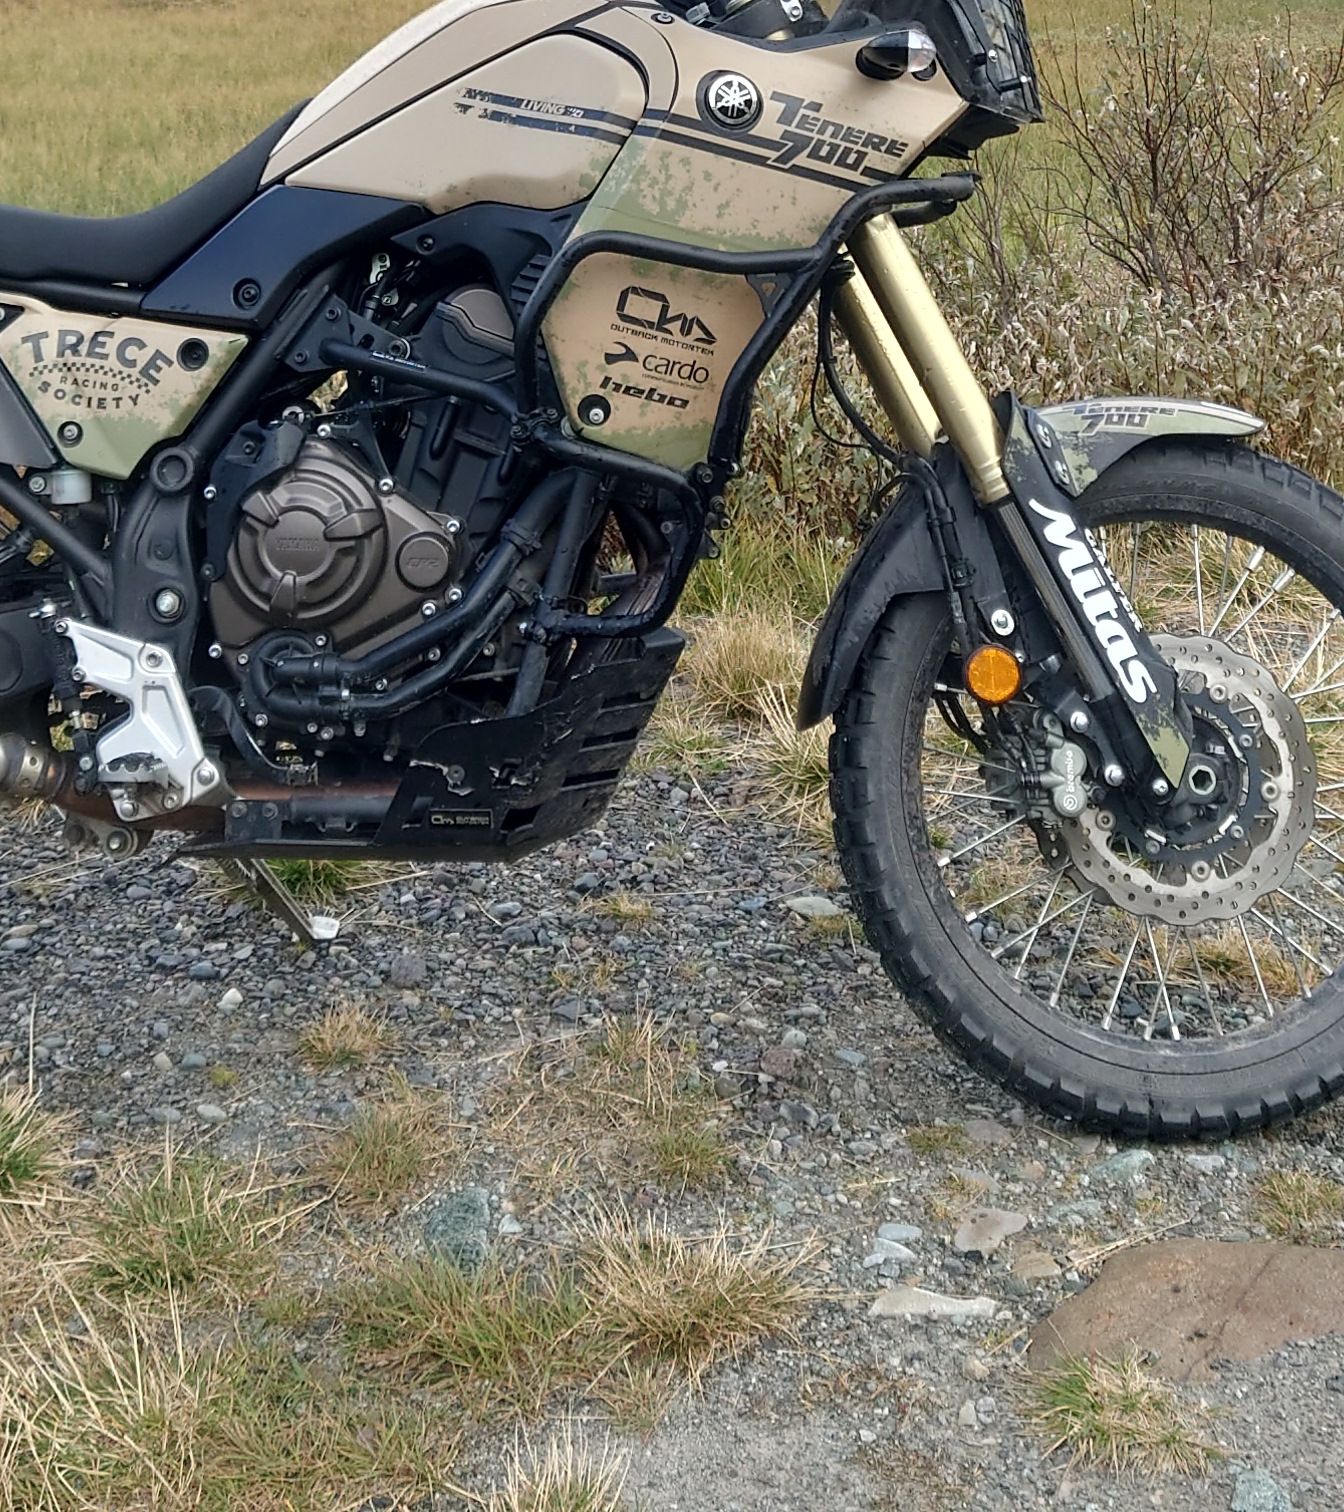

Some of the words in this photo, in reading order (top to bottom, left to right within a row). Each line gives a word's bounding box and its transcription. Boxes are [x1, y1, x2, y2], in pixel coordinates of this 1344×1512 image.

[520, 99, 566, 116] LIVING
[771, 130, 868, 172] 700
[610, 323, 658, 341] OUTBACK
[661, 337, 714, 356] MOTORTEK
[21, 329, 174, 386] TRECE
[642, 354, 710, 384] cardo
[38, 380, 140, 409] SOCIETY
[60, 376, 119, 392] RACING
[599, 376, 690, 409] hebo
[1079, 413, 1150, 436] 700
[1028, 498, 1158, 703] Mitas
